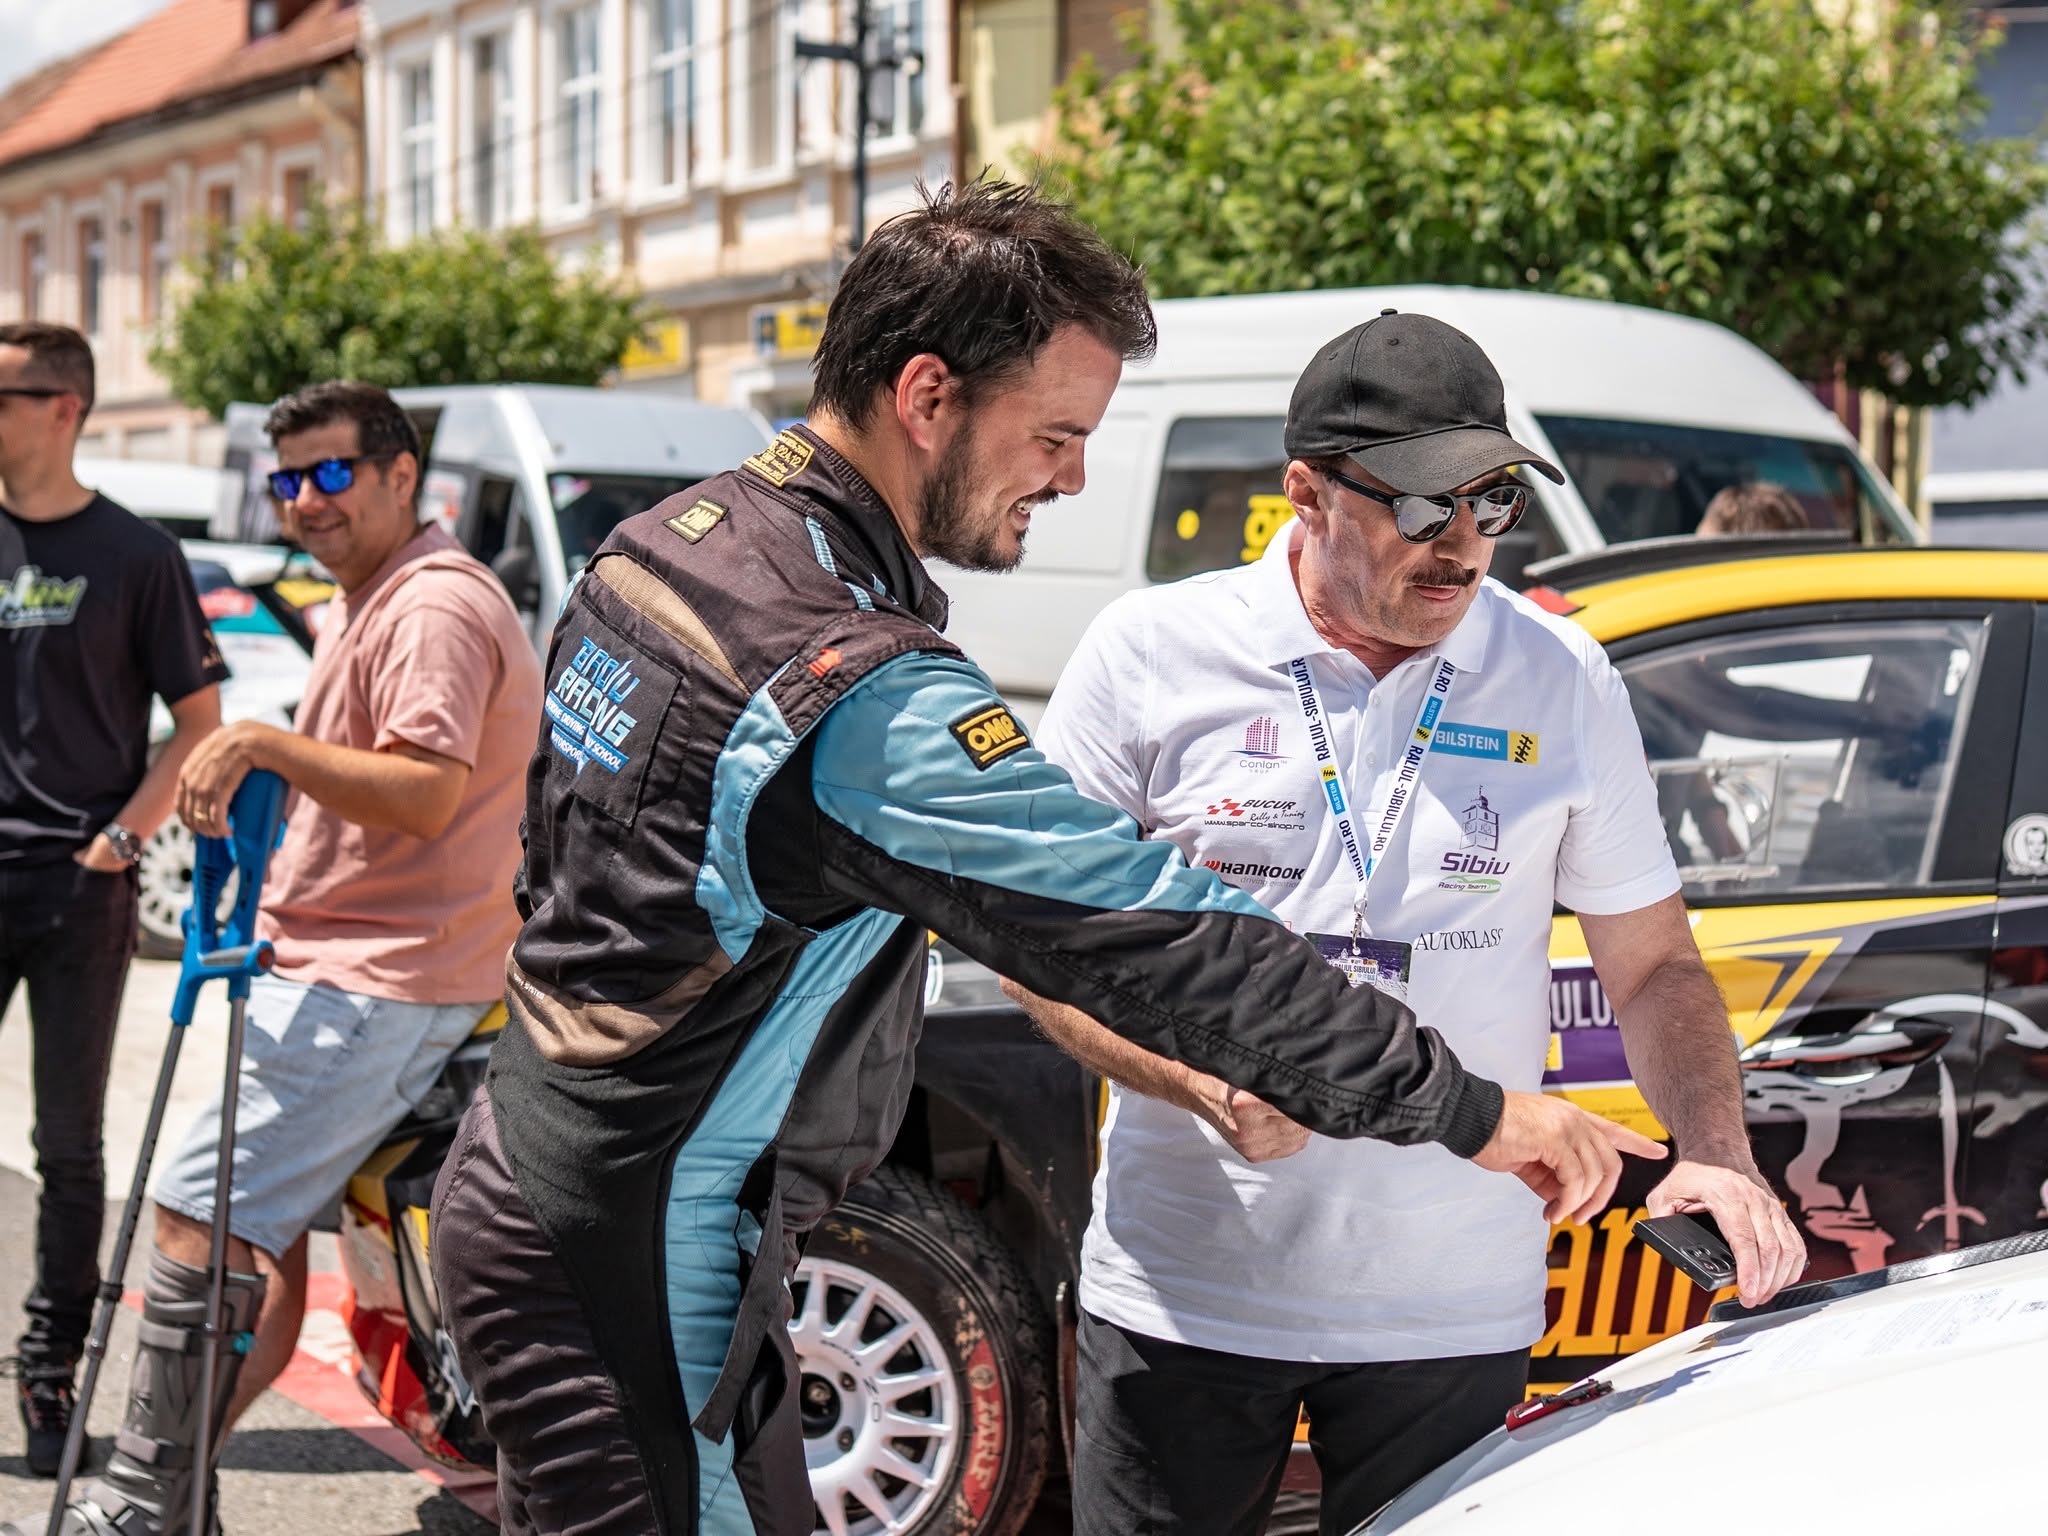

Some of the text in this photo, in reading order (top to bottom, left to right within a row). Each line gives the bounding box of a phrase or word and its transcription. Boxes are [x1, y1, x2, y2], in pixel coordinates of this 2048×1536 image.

[679, 507, 718, 531] OMP
[1291, 657, 1331, 761] RALIUL-SIBIULUI.R
[1425, 700, 1438, 726] BILSTEIN
[967, 714, 1017, 752] OMP
[1435, 730, 1499, 751] BILSTEIN
[593, 742, 623, 771] SCHOOL
[1241, 799, 1296, 810] BUCUR
[1249, 812, 1271, 823] Rally
[1281, 809, 1306, 820] Tuning
[1204, 819, 1305, 831] www.sparco-shop.ro
[1440, 852, 1511, 875] Sibiu
[1240, 876, 1268, 886] driving
[1438, 882, 1466, 891] Racing
[1415, 928, 1504, 951] AUTOKLASS
